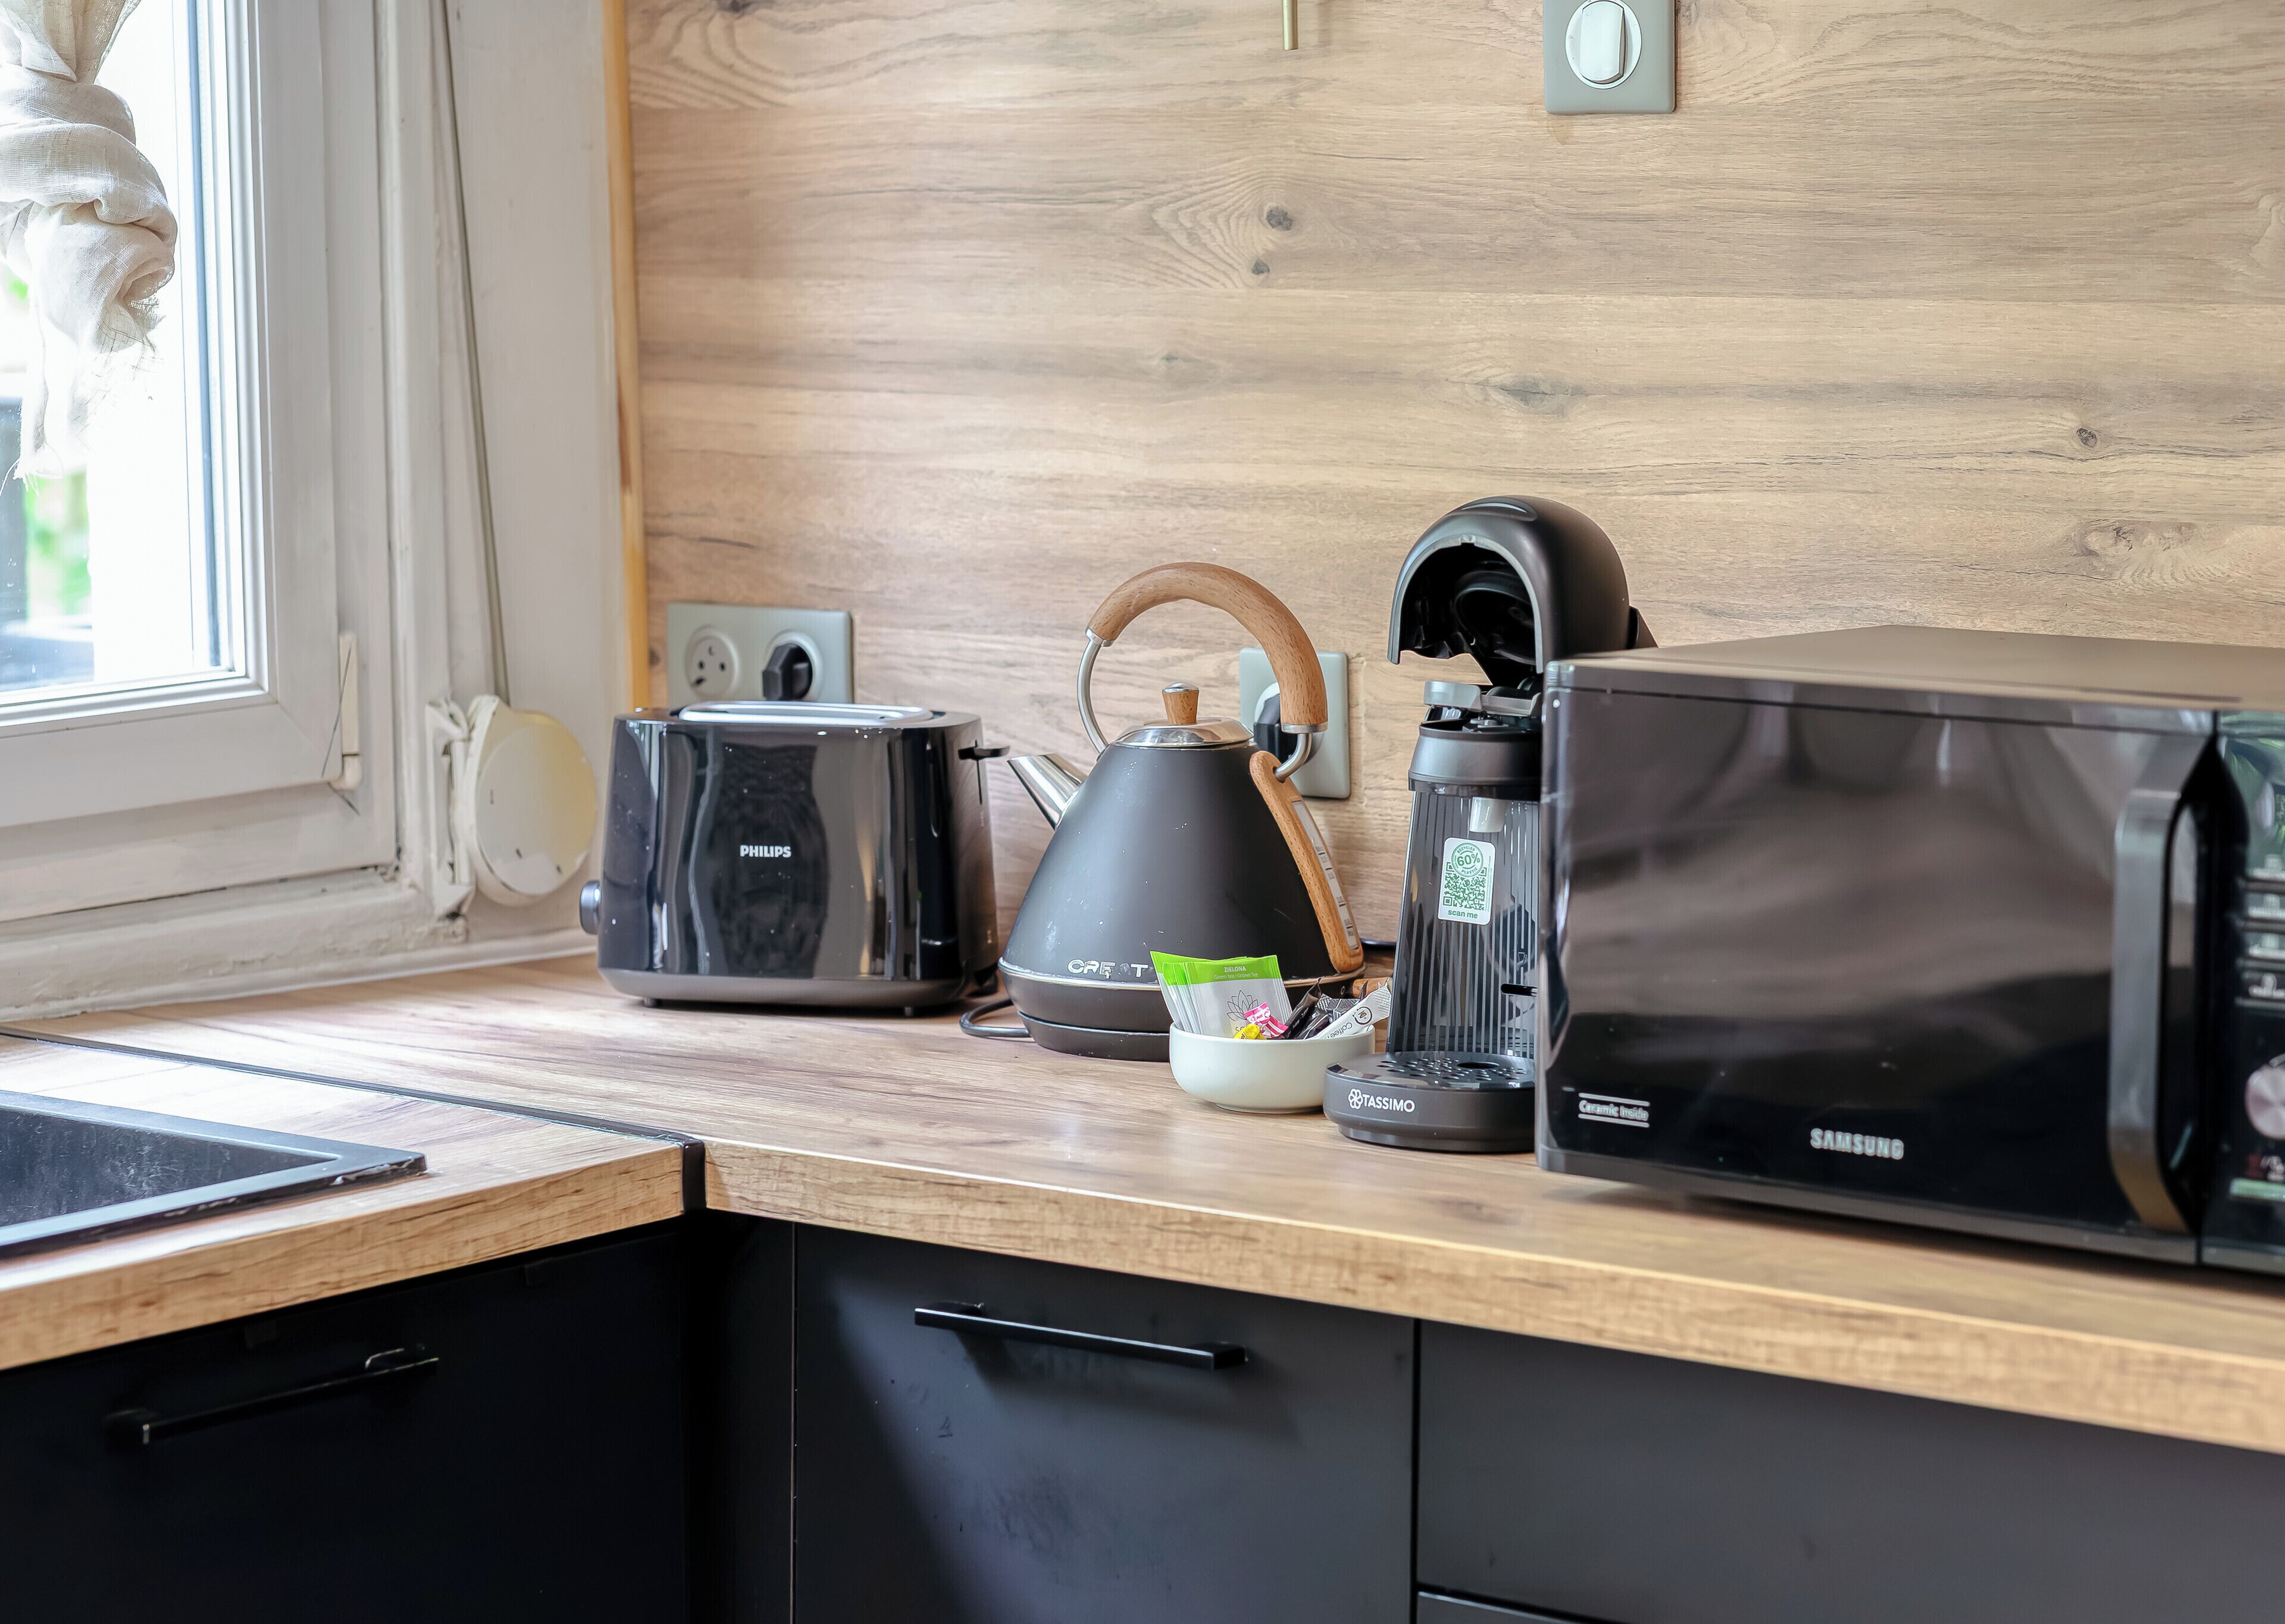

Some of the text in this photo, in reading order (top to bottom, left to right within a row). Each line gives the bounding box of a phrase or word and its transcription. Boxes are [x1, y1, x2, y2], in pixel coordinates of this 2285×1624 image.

[740, 845, 791, 858] PHILIPS
[1457, 852, 1480, 866] 60%
[1330, 1022, 1353, 1038] Coffee
[1362, 1093, 1415, 1112] TASSIMO
[1579, 1100, 1649, 1121] Ceramic Inside
[1810, 1128, 1904, 1160] SAMSUNG
